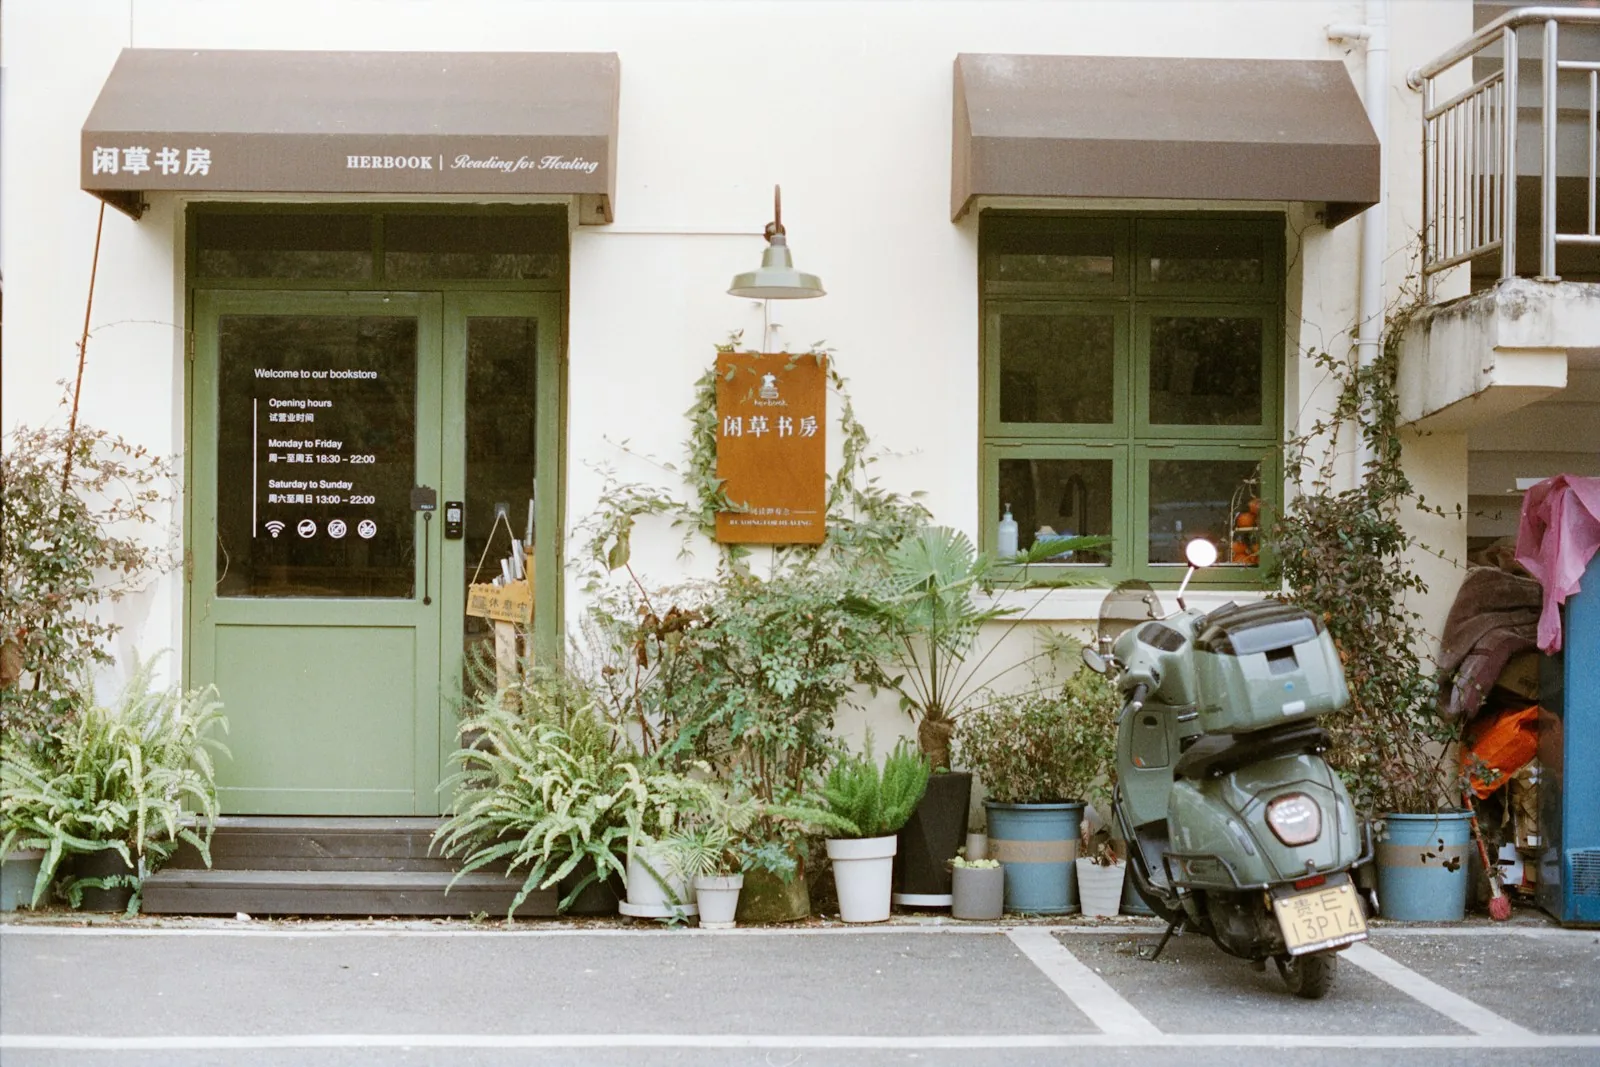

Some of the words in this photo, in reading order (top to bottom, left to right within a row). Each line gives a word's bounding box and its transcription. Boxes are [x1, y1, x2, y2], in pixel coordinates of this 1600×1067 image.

[92, 146, 212, 177] 闲草书房
[346, 155, 433, 169] HERBOOK
[450, 154, 514, 172] Reading
[512, 155, 535, 172] for
[538, 155, 599, 174] Healing
[254, 368, 299, 379] Welcome
[300, 369, 310, 379] to
[312, 371, 328, 379] our
[329, 369, 377, 379] bookstore
[269, 398, 306, 409] Opening
[307, 398, 332, 408] hours
[269, 413, 315, 423] 试营业时间
[723, 415, 819, 438] 闲草书房
[268, 439, 303, 450] Monday
[304, 439, 313, 448] to
[314, 439, 343, 450] Friday
[268, 453, 314, 463] 周一至周五
[316, 455, 341, 464] 18:30
[350, 455, 376, 464] 22:00
[268, 479, 307, 491] Saturday
[309, 480, 318, 488] to
[319, 479, 353, 490] Sunday
[268, 494, 313, 504] 周六至周日
[315, 495, 341, 504] 13:00
[350, 495, 376, 504] 22:00
[1292, 908, 1360, 944] 13P14
